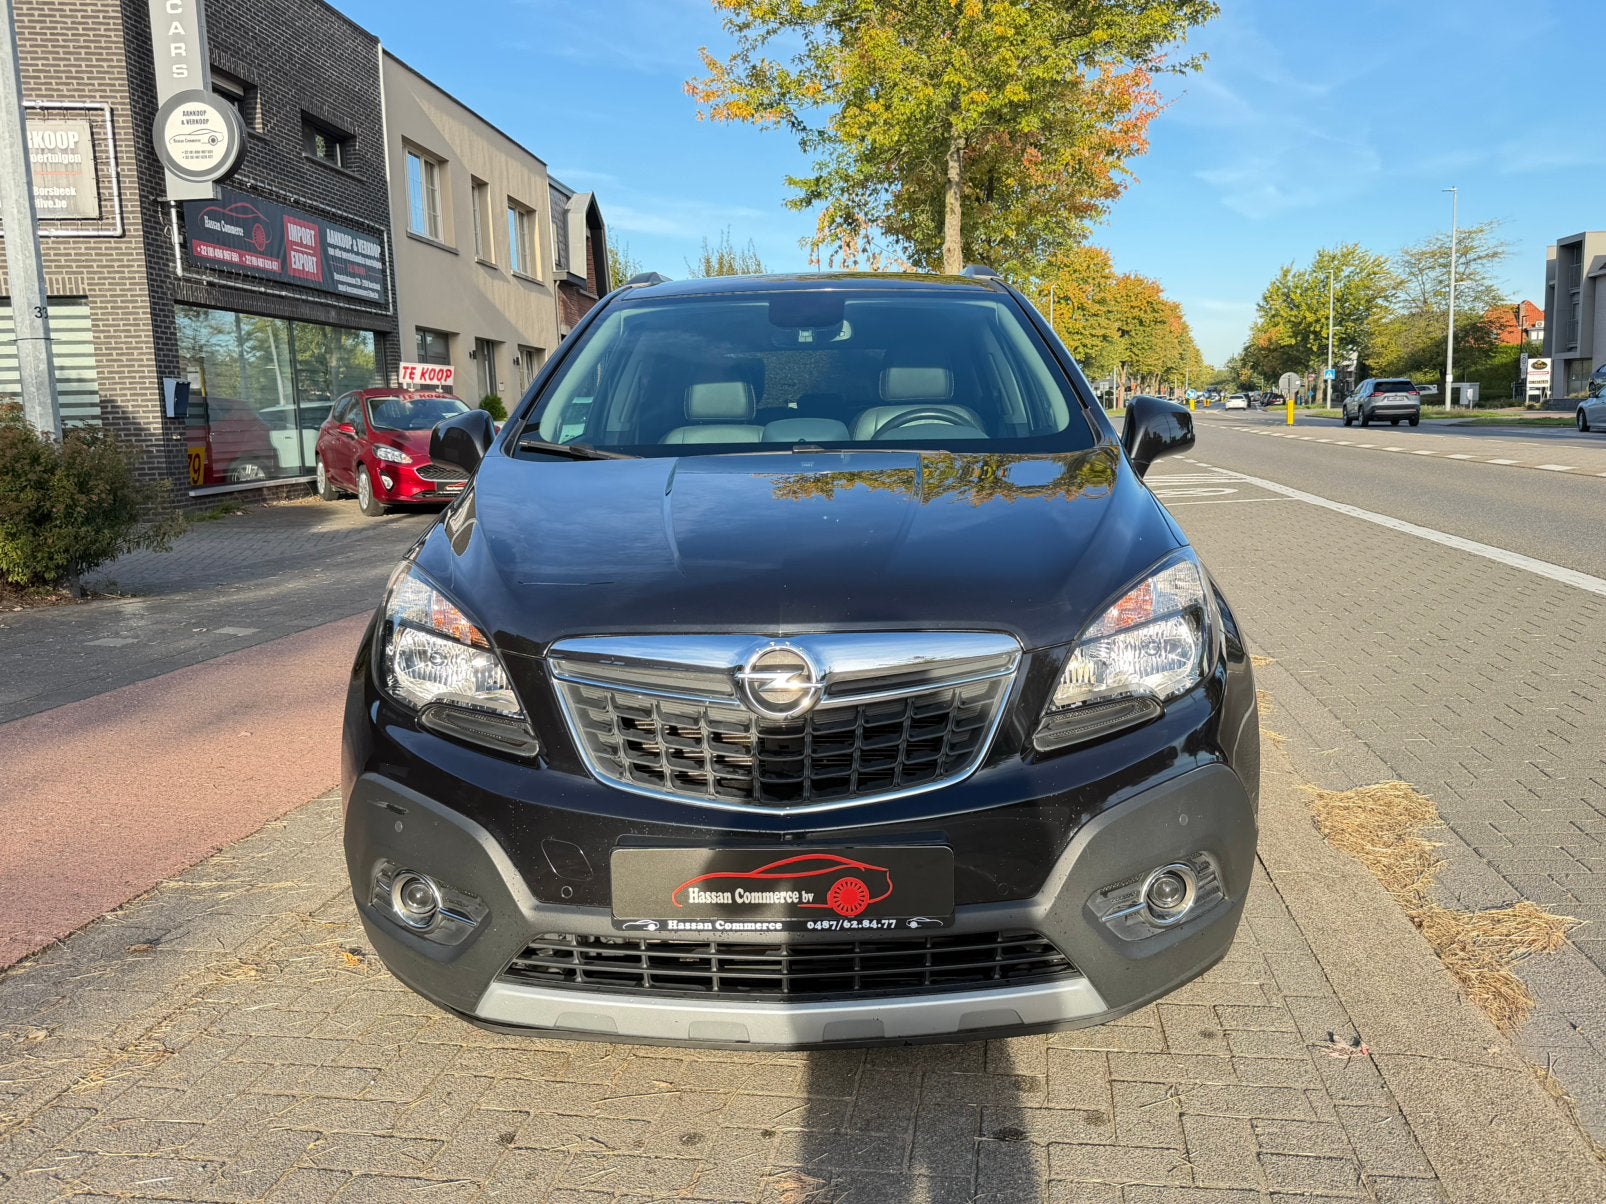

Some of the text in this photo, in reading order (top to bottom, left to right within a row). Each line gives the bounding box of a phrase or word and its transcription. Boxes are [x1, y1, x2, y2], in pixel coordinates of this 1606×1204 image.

[165, 0, 188, 78] CARS
[204, 215, 244, 236] Hassan Commerce
[287, 222, 315, 247] IMPORT
[201, 245, 208, 256] 32
[326, 228, 353, 250] AANKOOP
[357, 238, 381, 258] VERKOOP
[290, 251, 317, 274] EXPORT
[402, 366, 453, 382] TE KOOP
[688, 887, 814, 904] Hassan Commerce bv
[667, 919, 897, 931] Hassan Commerce 0487/62.84.77
